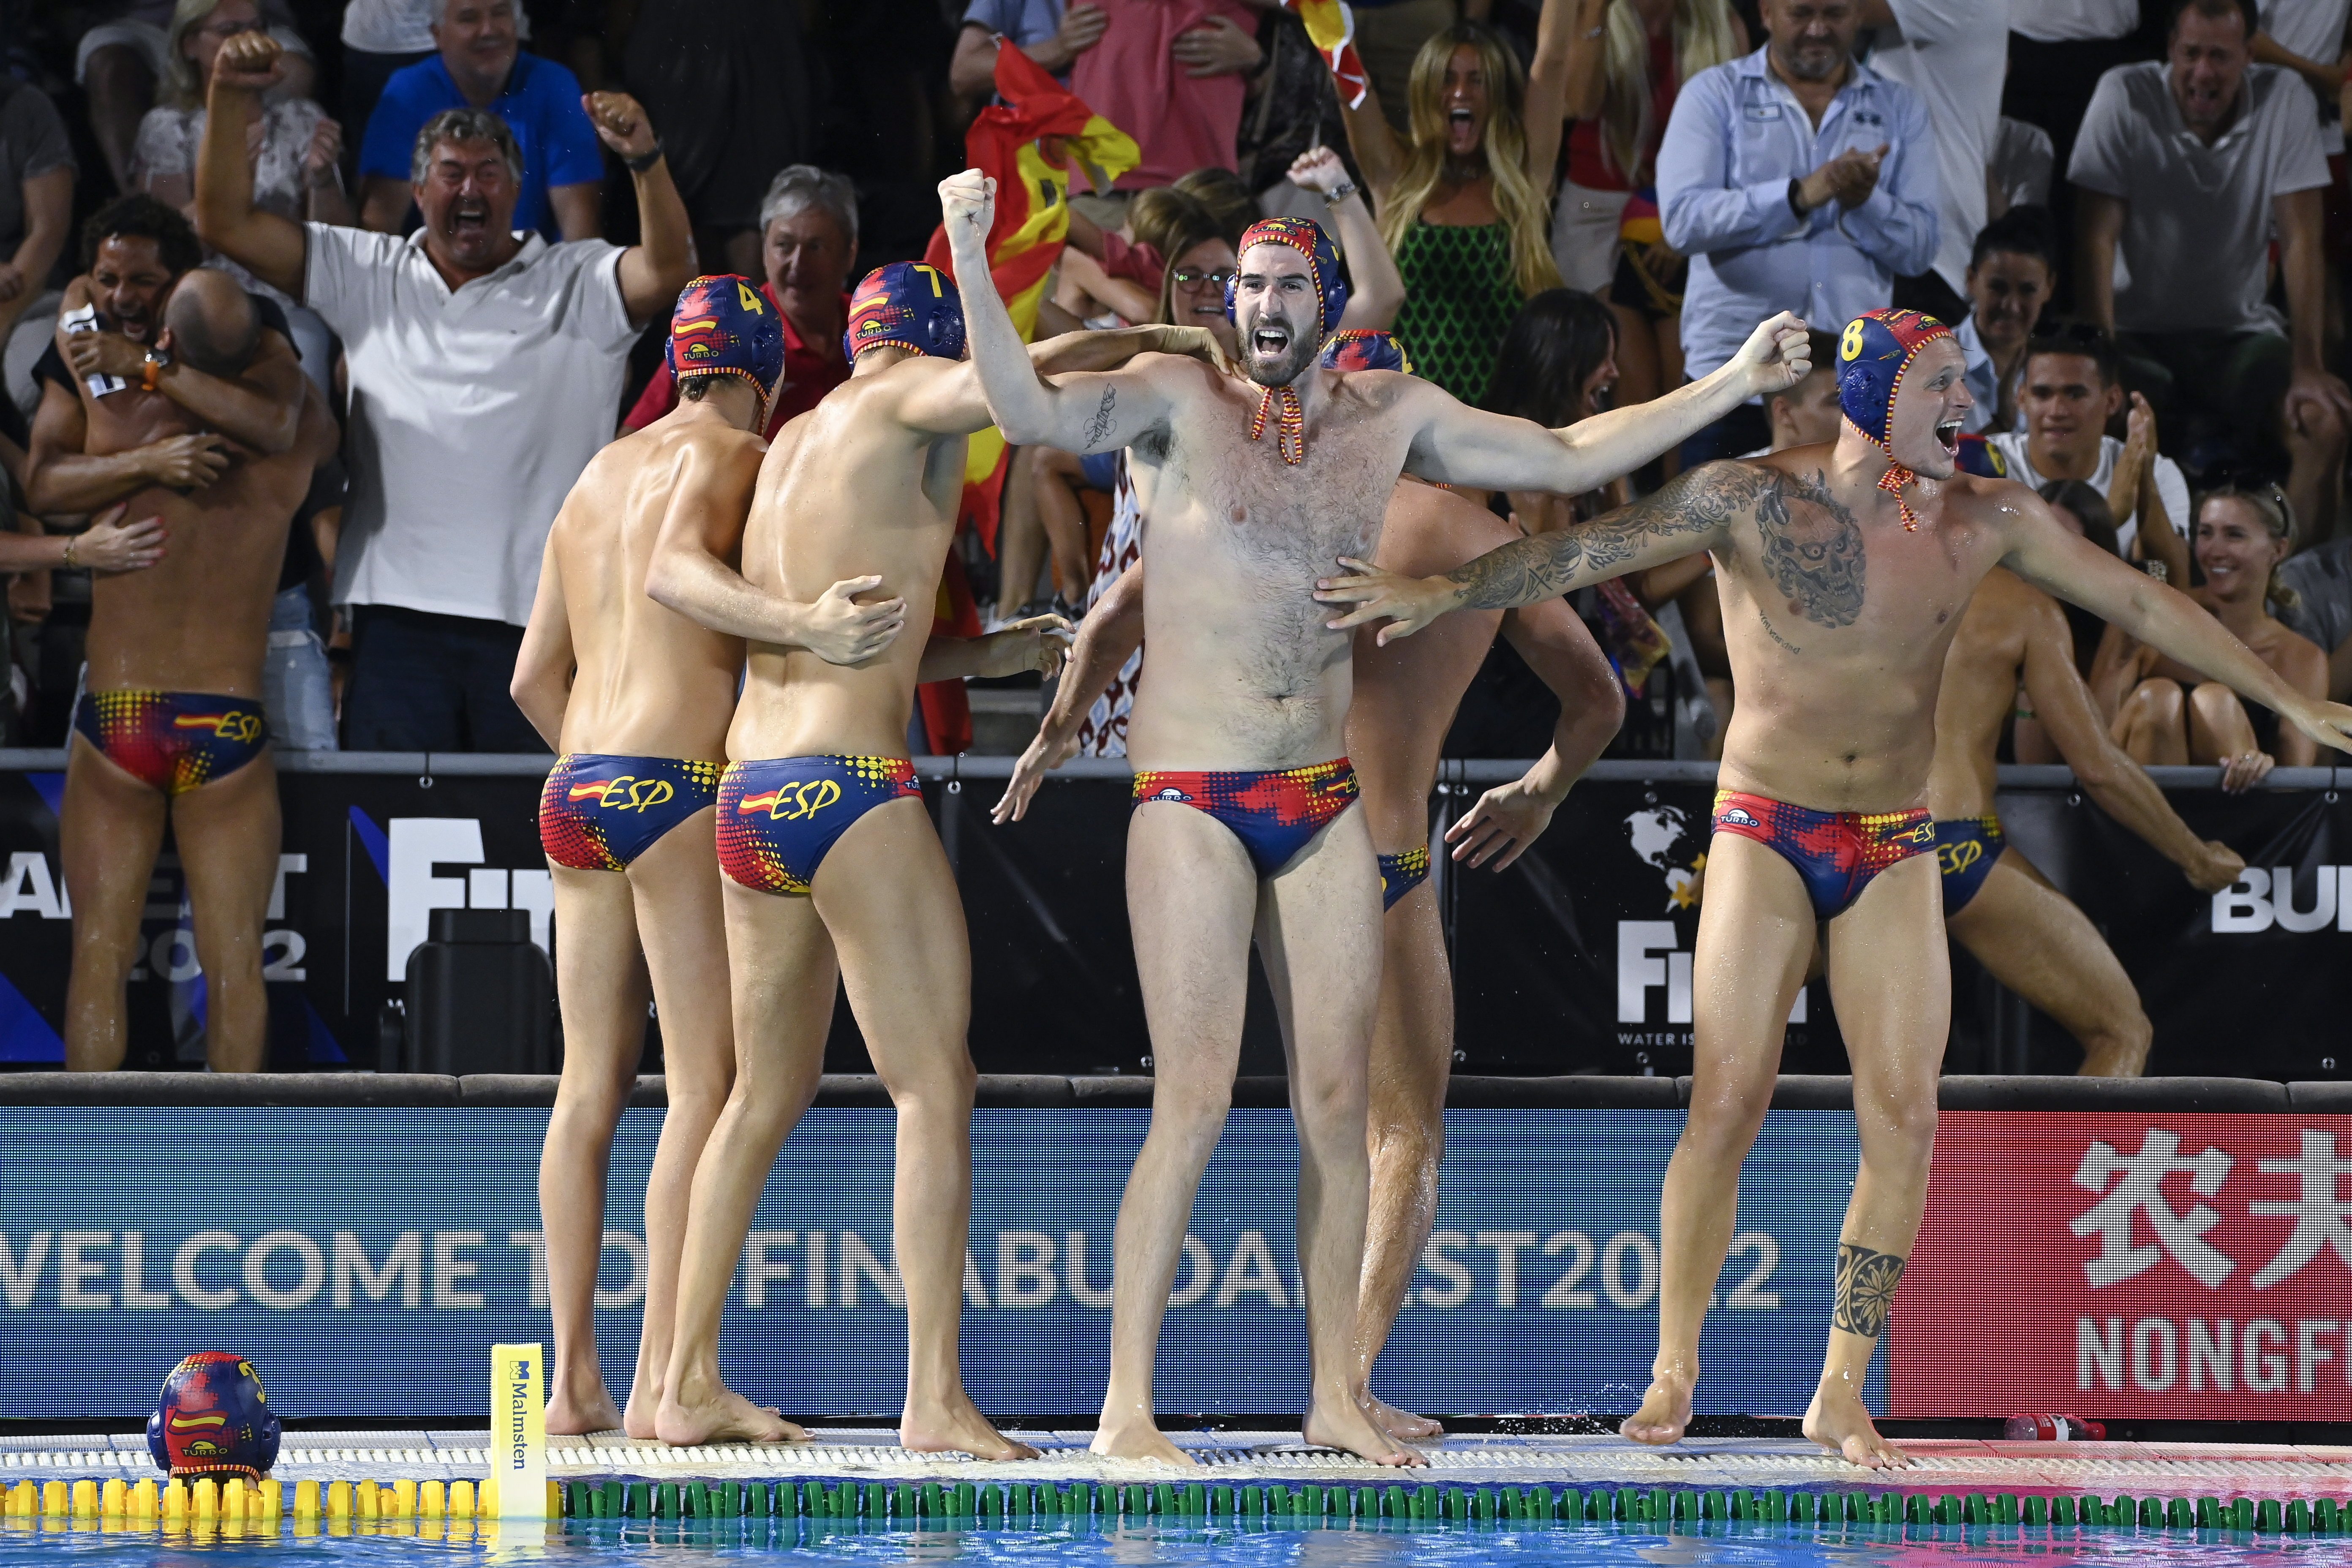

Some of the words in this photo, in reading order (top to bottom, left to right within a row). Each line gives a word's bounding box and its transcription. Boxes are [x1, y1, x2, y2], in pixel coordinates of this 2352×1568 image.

[1255, 226, 1296, 235] TURBO
[912, 265, 942, 297] 7
[738, 282, 763, 315] 4
[857, 325, 891, 339] TURBO
[1841, 319, 1864, 361] 8
[684, 350, 719, 359] TURBO
[214, 711, 261, 745] ESP
[600, 776, 674, 813] ESP
[770, 779, 841, 820] ESP
[1721, 816, 1758, 826] TURBO
[2212, 865, 2352, 934] BU
[1617, 1033, 1675, 1046] WATER
[2077, 1317, 2352, 1392] NONGF
[238, 1362, 265, 1404] 3
[512, 1383, 528, 1470] Malmsten
